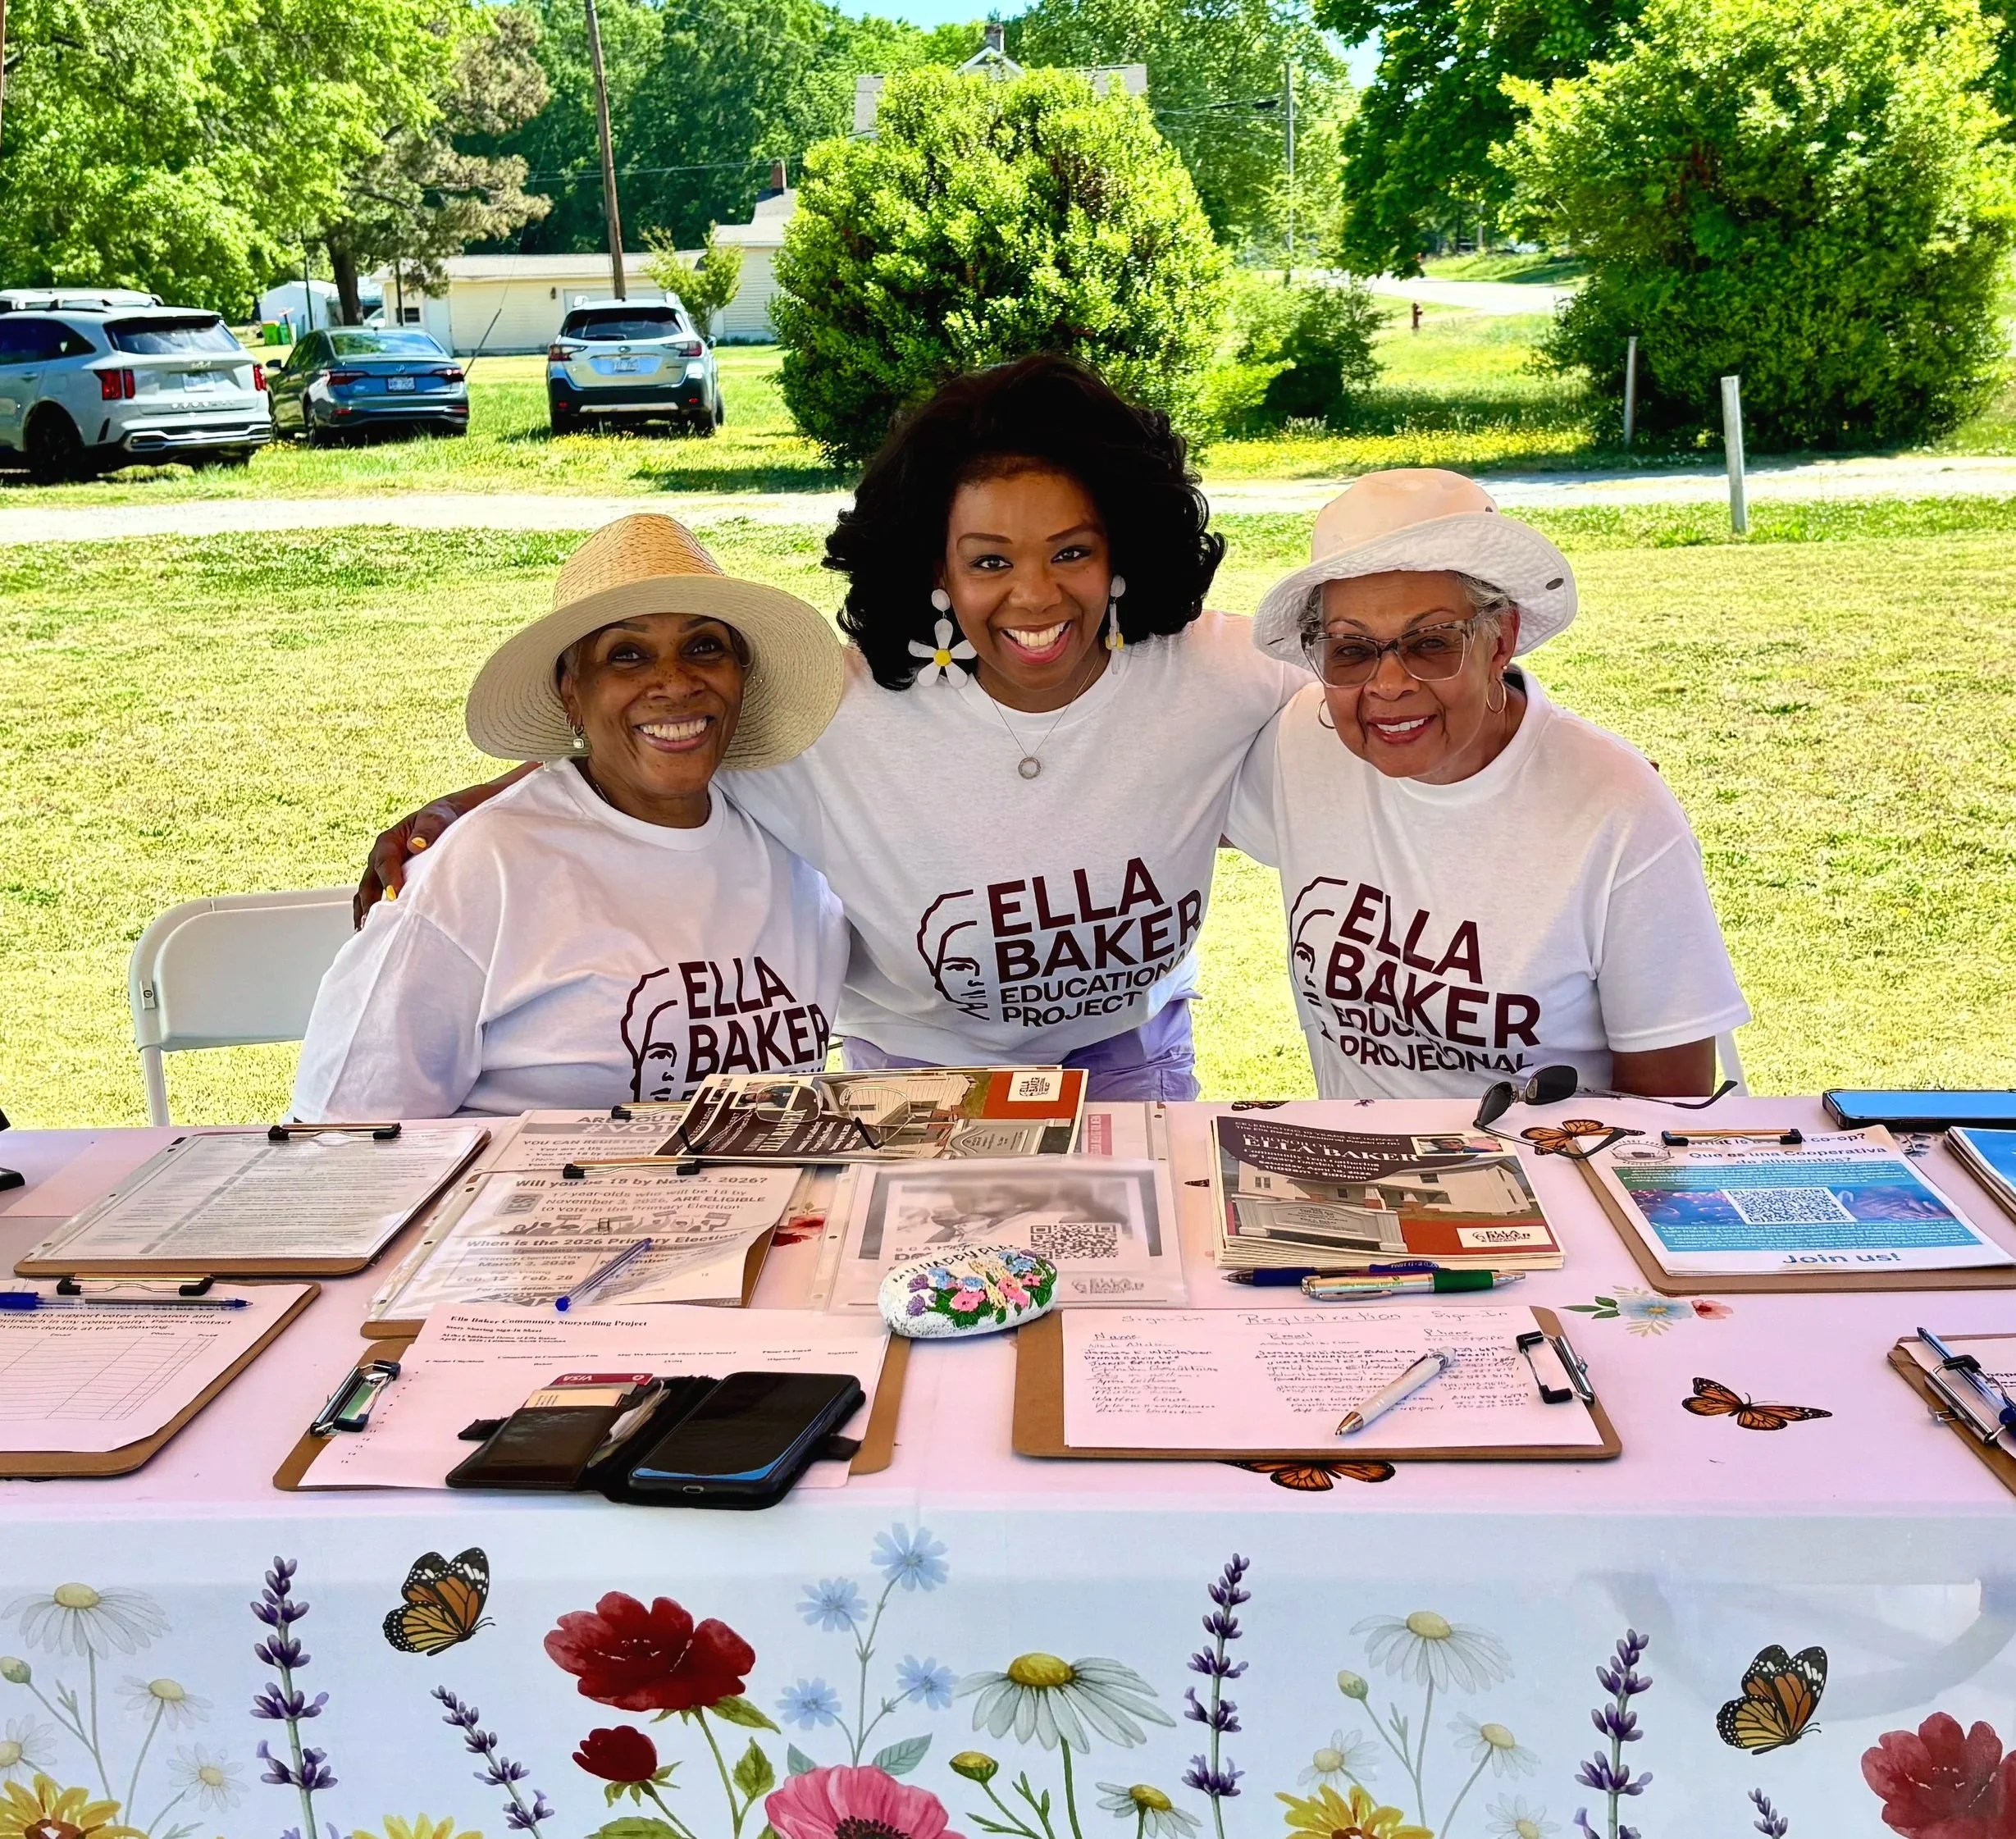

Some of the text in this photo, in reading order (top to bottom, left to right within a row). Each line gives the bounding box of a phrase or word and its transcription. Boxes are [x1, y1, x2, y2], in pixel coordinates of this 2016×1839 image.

[987, 857, 1165, 938] ELLA
[994, 890, 1202, 984] BAKER
[1339, 883, 1483, 984] ELLA
[678, 956, 796, 1020] ELLA
[1325, 942, 1541, 1049] BAKER
[1001, 991, 1143, 1027] PROJECT
[685, 1003, 831, 1084] BAKER
[1244, 1137, 1421, 1162] ELLA BAKER
[1809, 1133, 1867, 1143] co-op?
[1783, 1147, 1887, 1157] Cooperativa
[632, 1178, 652, 1186] by
[918, 1249, 979, 1271] HAPPY
[1782, 1252, 1902, 1264] Join us!
[1237, 1312, 1401, 1326] Registration
[1093, 1331, 1140, 1341] Name
